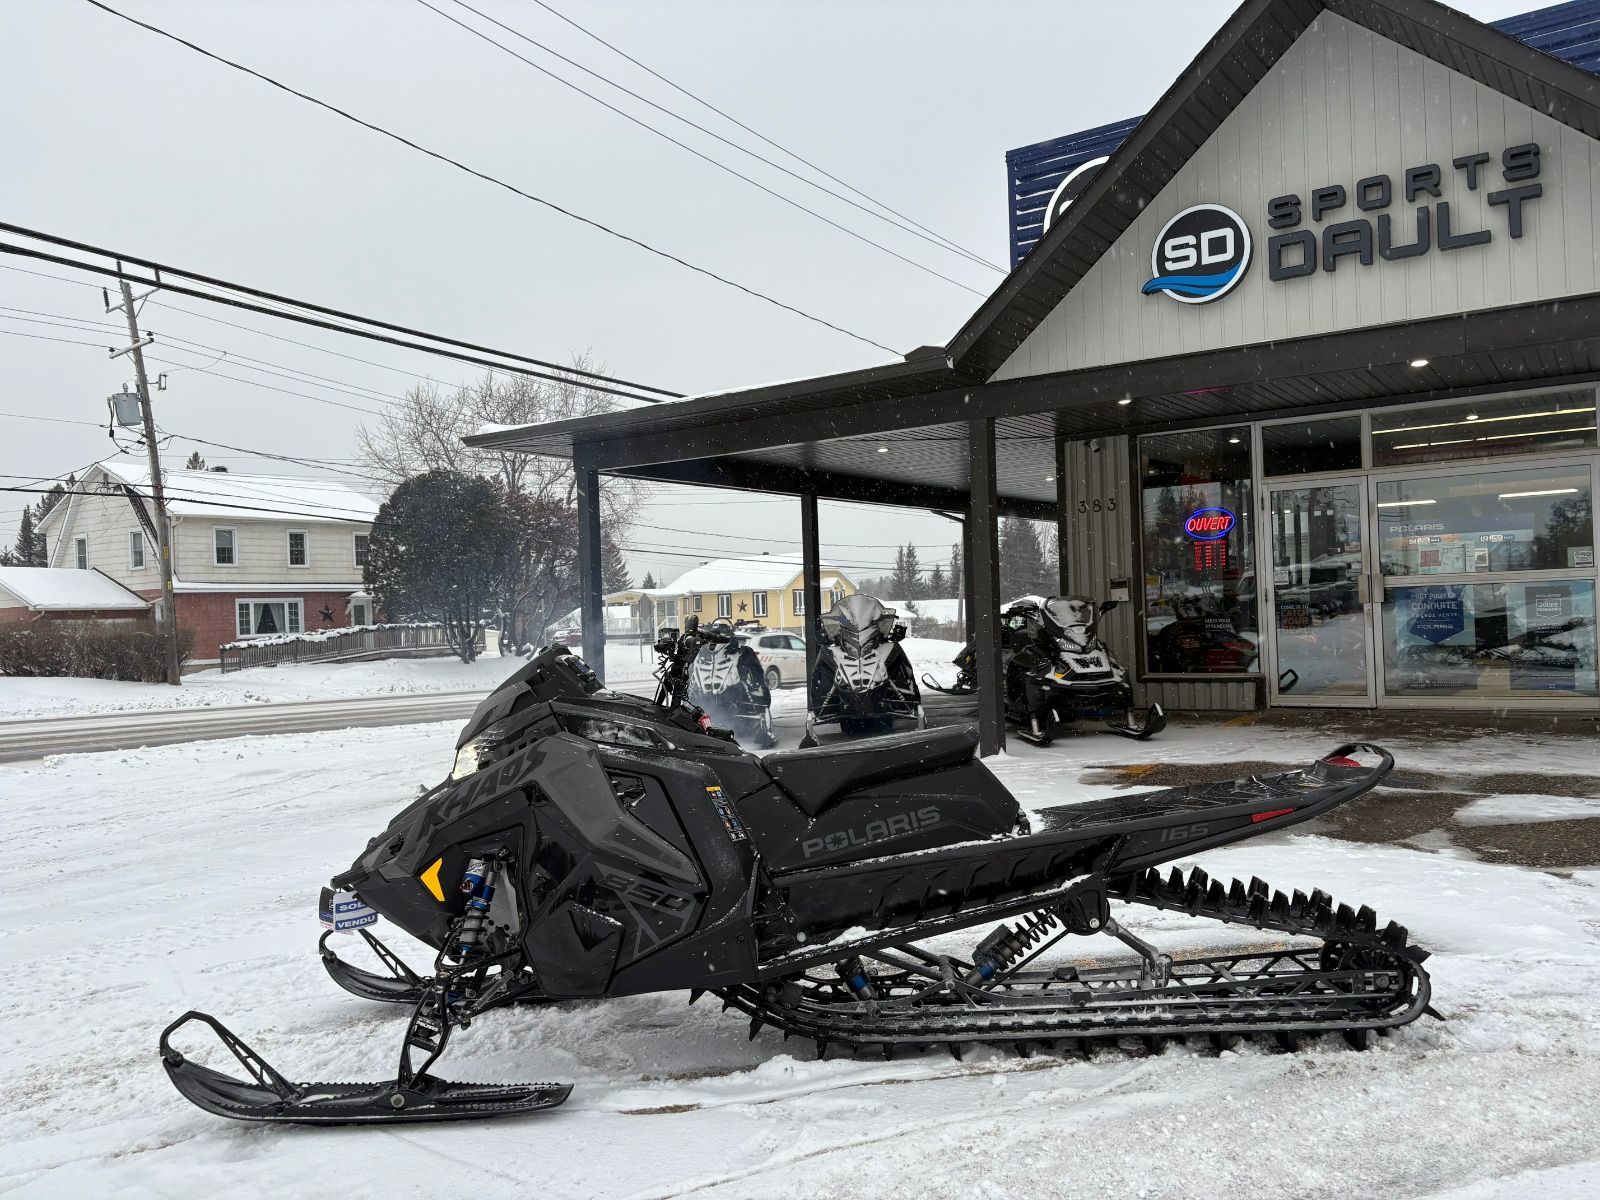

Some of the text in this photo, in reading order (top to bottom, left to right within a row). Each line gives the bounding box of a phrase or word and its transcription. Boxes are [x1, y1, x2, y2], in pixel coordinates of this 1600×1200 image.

[1268, 143, 1540, 229] SPORTS
[1269, 183, 1542, 282] DAULT
[1164, 227, 1234, 271] SD
[1078, 498, 1116, 514] 383
[1187, 516, 1231, 532] OUVERT
[1389, 523, 1445, 533] POLARIS
[1411, 601, 1458, 610] CONDUITE
[802, 806, 941, 858] POLARIS
[1160, 823, 1209, 842] 165
[598, 873, 691, 911] 850
[339, 901, 365, 911] SOL
[337, 914, 376, 928] VENDU
